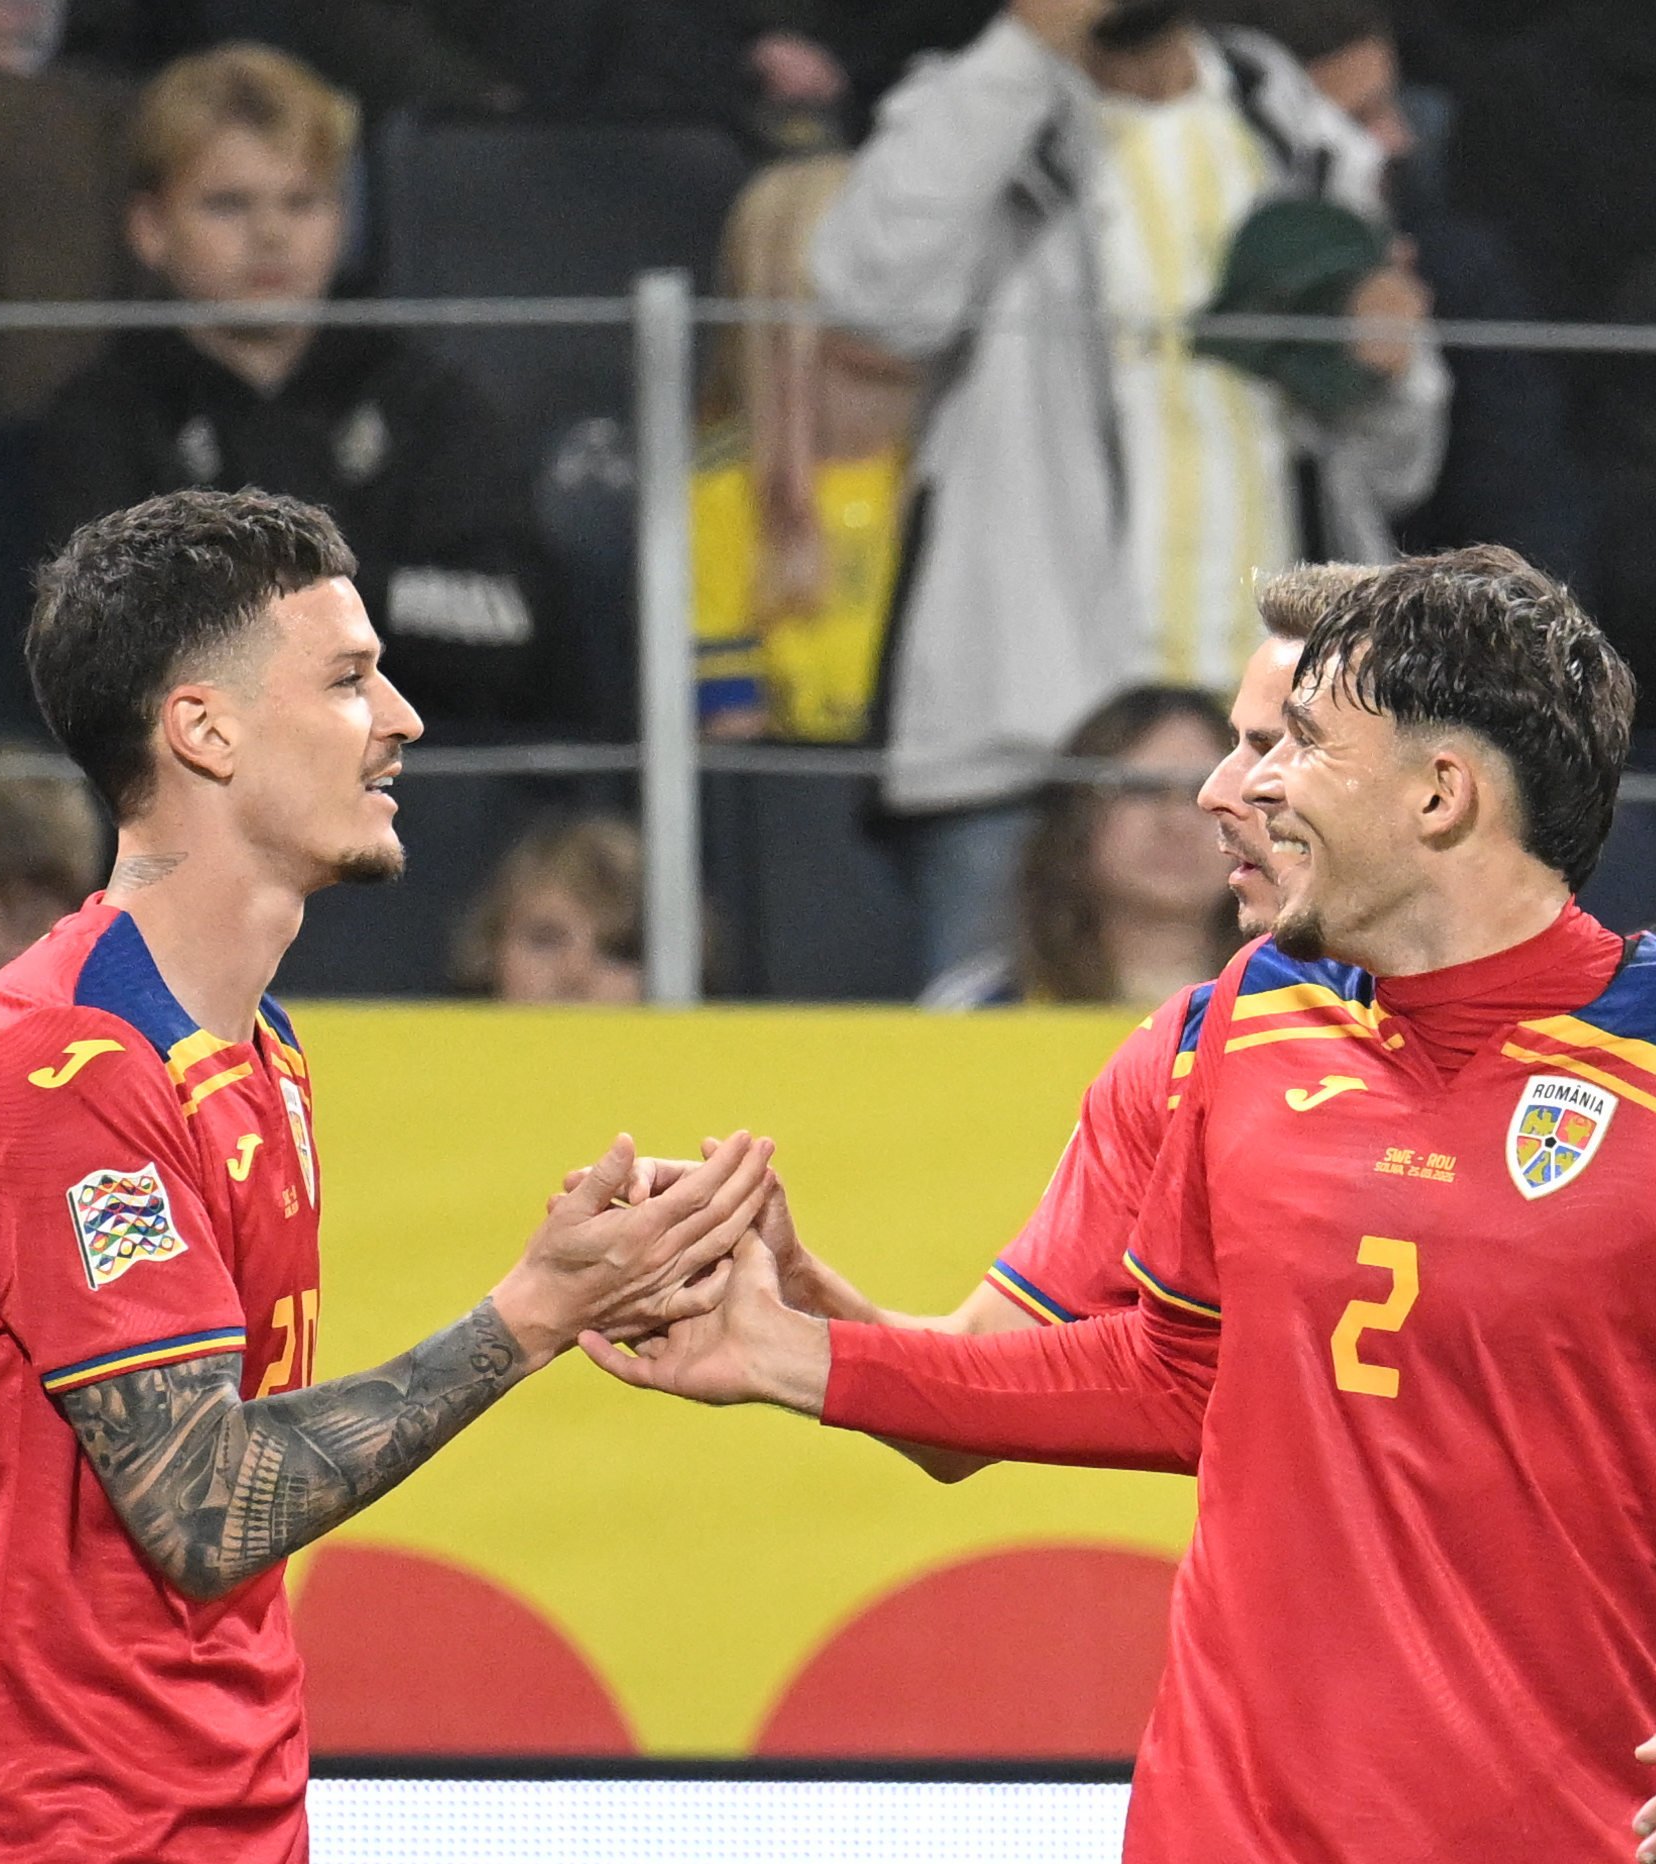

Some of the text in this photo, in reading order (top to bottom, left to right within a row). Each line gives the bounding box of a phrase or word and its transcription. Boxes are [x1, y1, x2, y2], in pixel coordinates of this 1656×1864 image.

[1532, 1083, 1604, 1115] ROMÂNIA
[1384, 1147, 1415, 1164] SWE
[1426, 1152, 1456, 1170] ROU
[1330, 1235, 1420, 1398] 2
